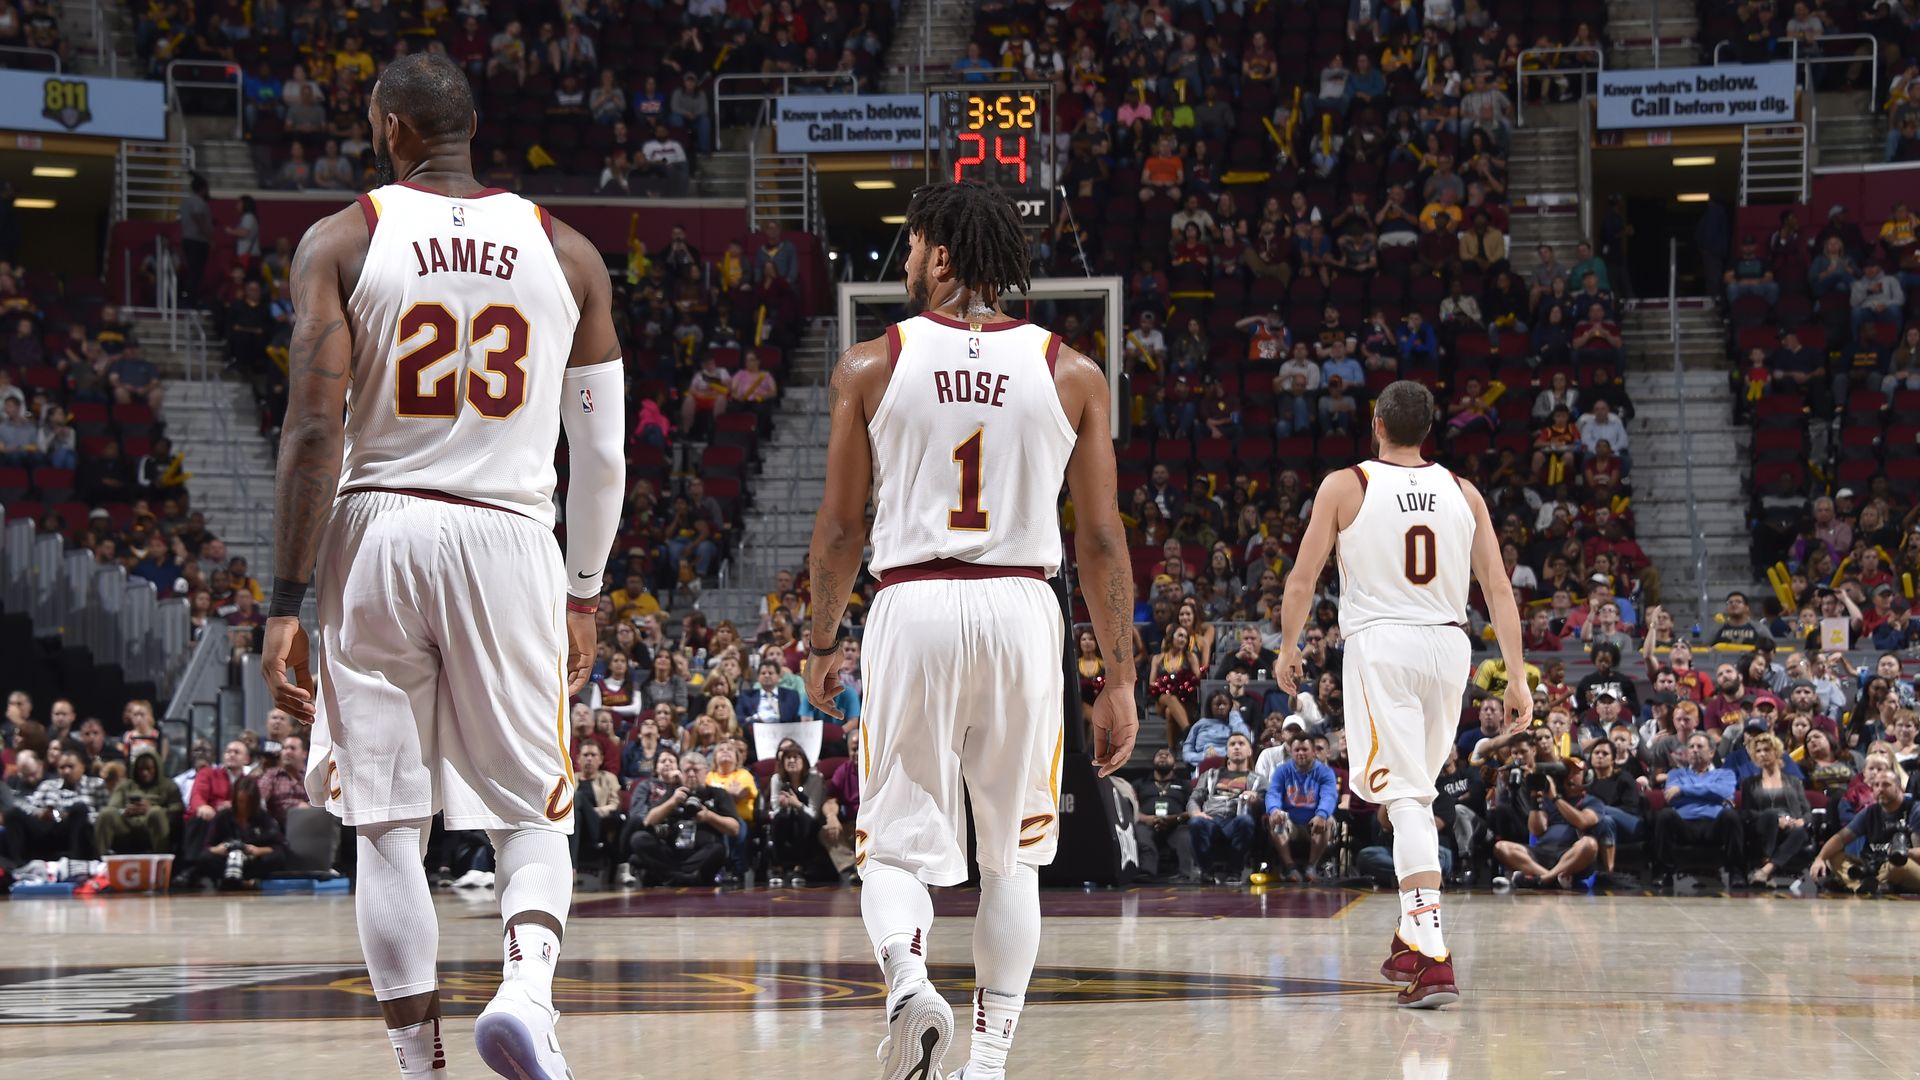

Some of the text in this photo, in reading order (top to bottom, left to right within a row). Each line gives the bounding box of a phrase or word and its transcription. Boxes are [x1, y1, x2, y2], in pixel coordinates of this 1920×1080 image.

[46, 79, 87, 112] 811
[1603, 74, 1758, 96] Know what's below.
[782, 103, 922, 122] Know what's below.
[968, 95, 1036, 129] 3:52
[1631, 96, 1789, 117] Call before you dig.
[808, 123, 844, 142] Call
[847, 126, 893, 141] before
[895, 128, 921, 143] you
[953, 132, 1028, 185] 24
[412, 237, 518, 281] JAMES
[395, 301, 531, 421] 23
[934, 370, 1010, 408] ROSE
[947, 427, 991, 532] 1
[1396, 492, 1437, 513] LOVE
[1404, 524, 1438, 586] 0
[117, 861, 142, 888] G
